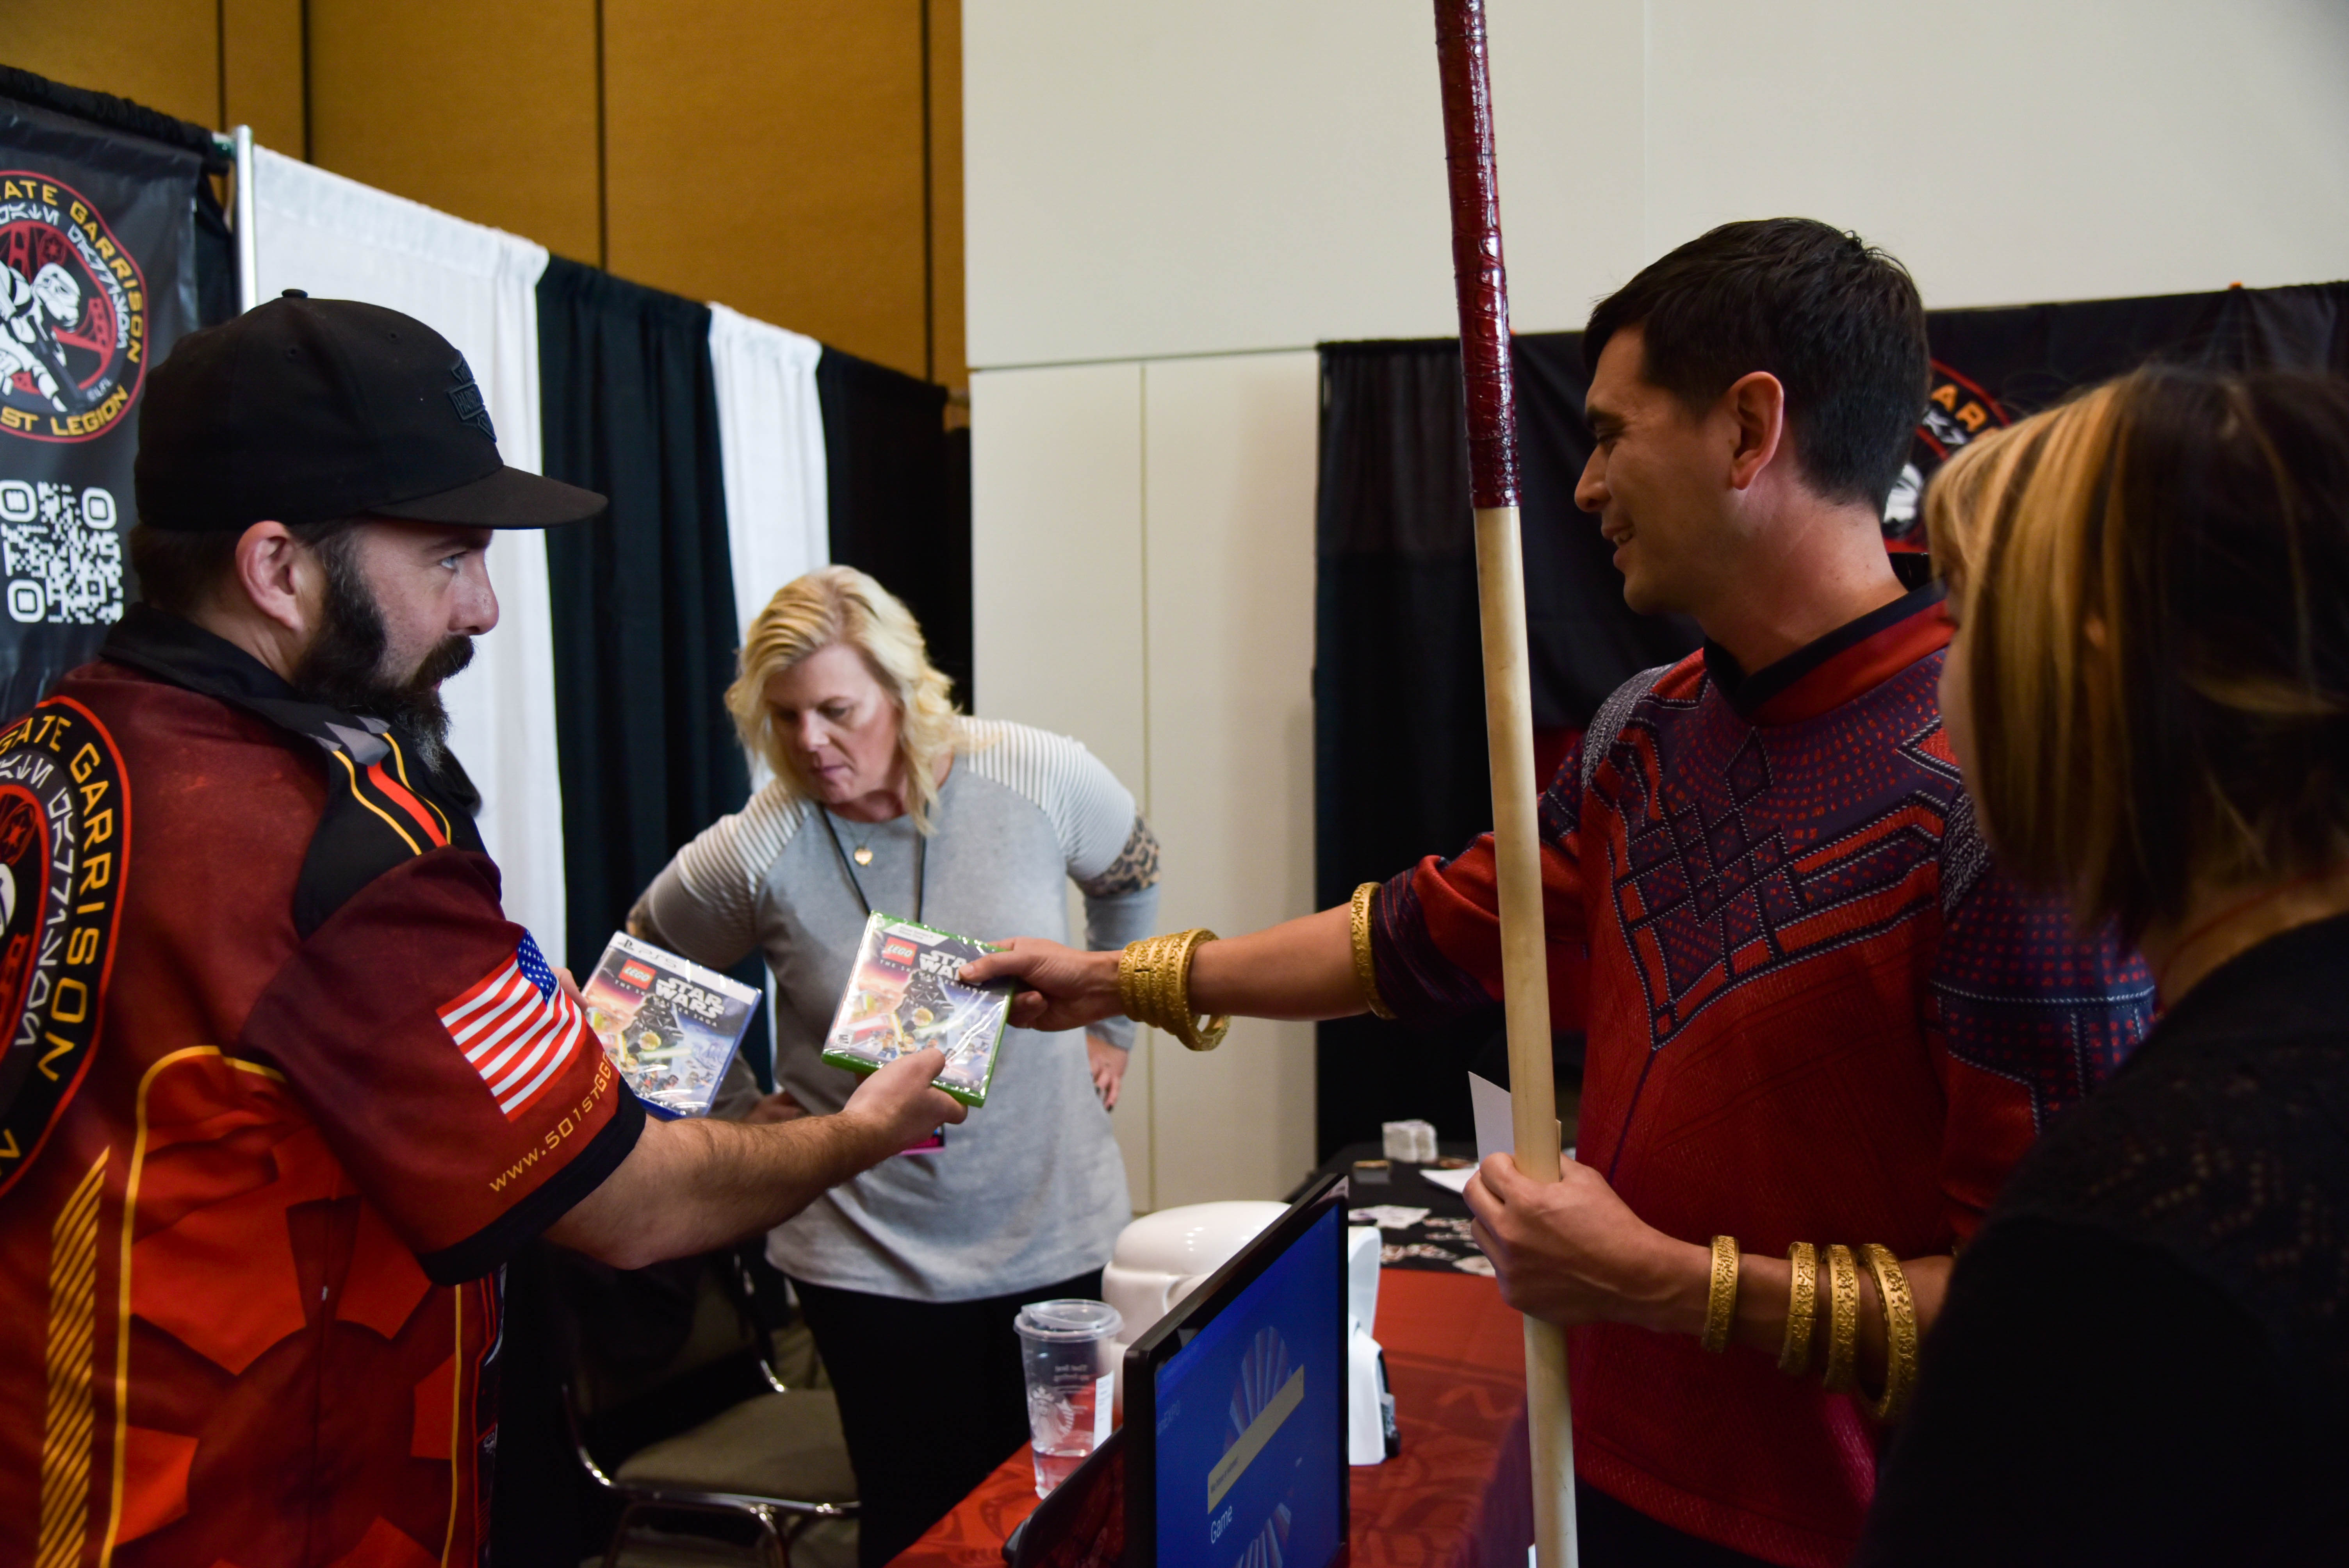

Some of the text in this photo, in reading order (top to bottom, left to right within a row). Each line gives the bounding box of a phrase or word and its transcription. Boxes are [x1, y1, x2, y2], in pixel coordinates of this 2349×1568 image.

[0, 180, 58, 206] ATE
[70, 200, 143, 363] GARRISON
[50, 383, 129, 436] LEGION
[37, 742, 112, 1082] GARRISON
[880, 960, 896, 968] THE
[888, 944, 913, 957] LEGO
[920, 950, 967, 969] STA
[625, 967, 651, 982] LEGO
[656, 982, 725, 1019] WARS
[657, 977, 724, 1008] STAR
[1211, 1505, 1232, 1544] Game
